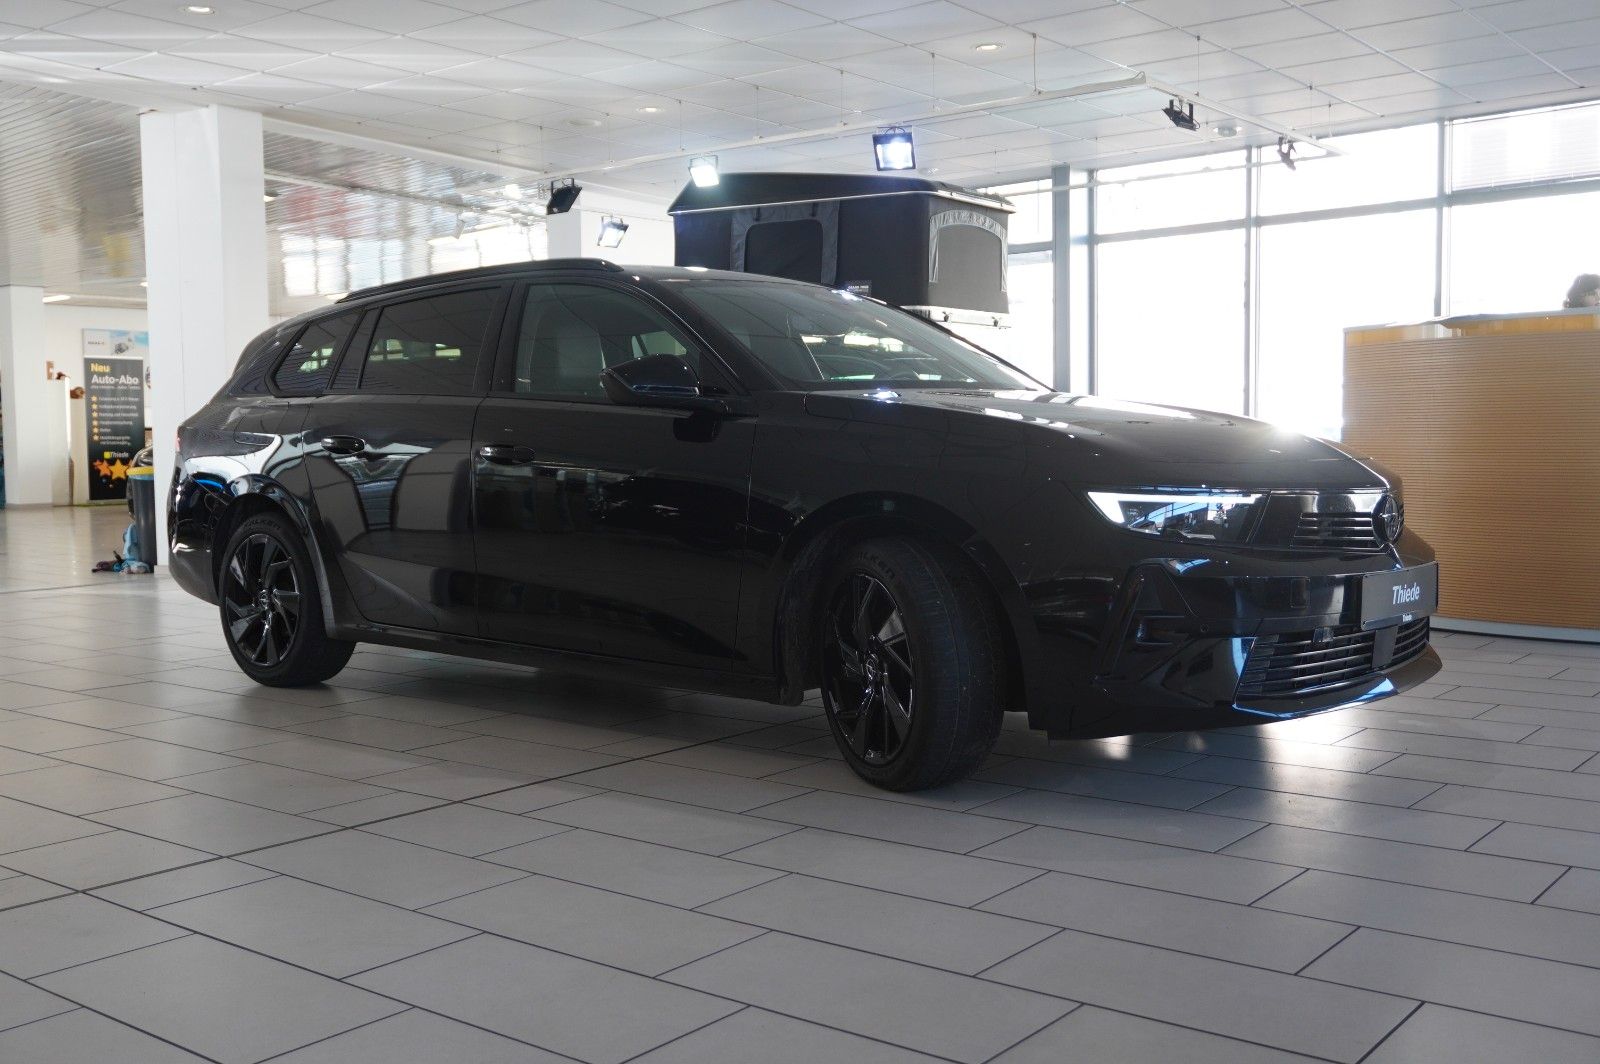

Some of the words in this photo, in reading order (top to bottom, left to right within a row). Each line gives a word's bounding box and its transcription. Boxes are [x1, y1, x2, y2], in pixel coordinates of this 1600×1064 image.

[90, 363, 110, 373] Neu
[91, 374, 139, 385] Auto-Abo
[1392, 582, 1420, 605] Thiede
